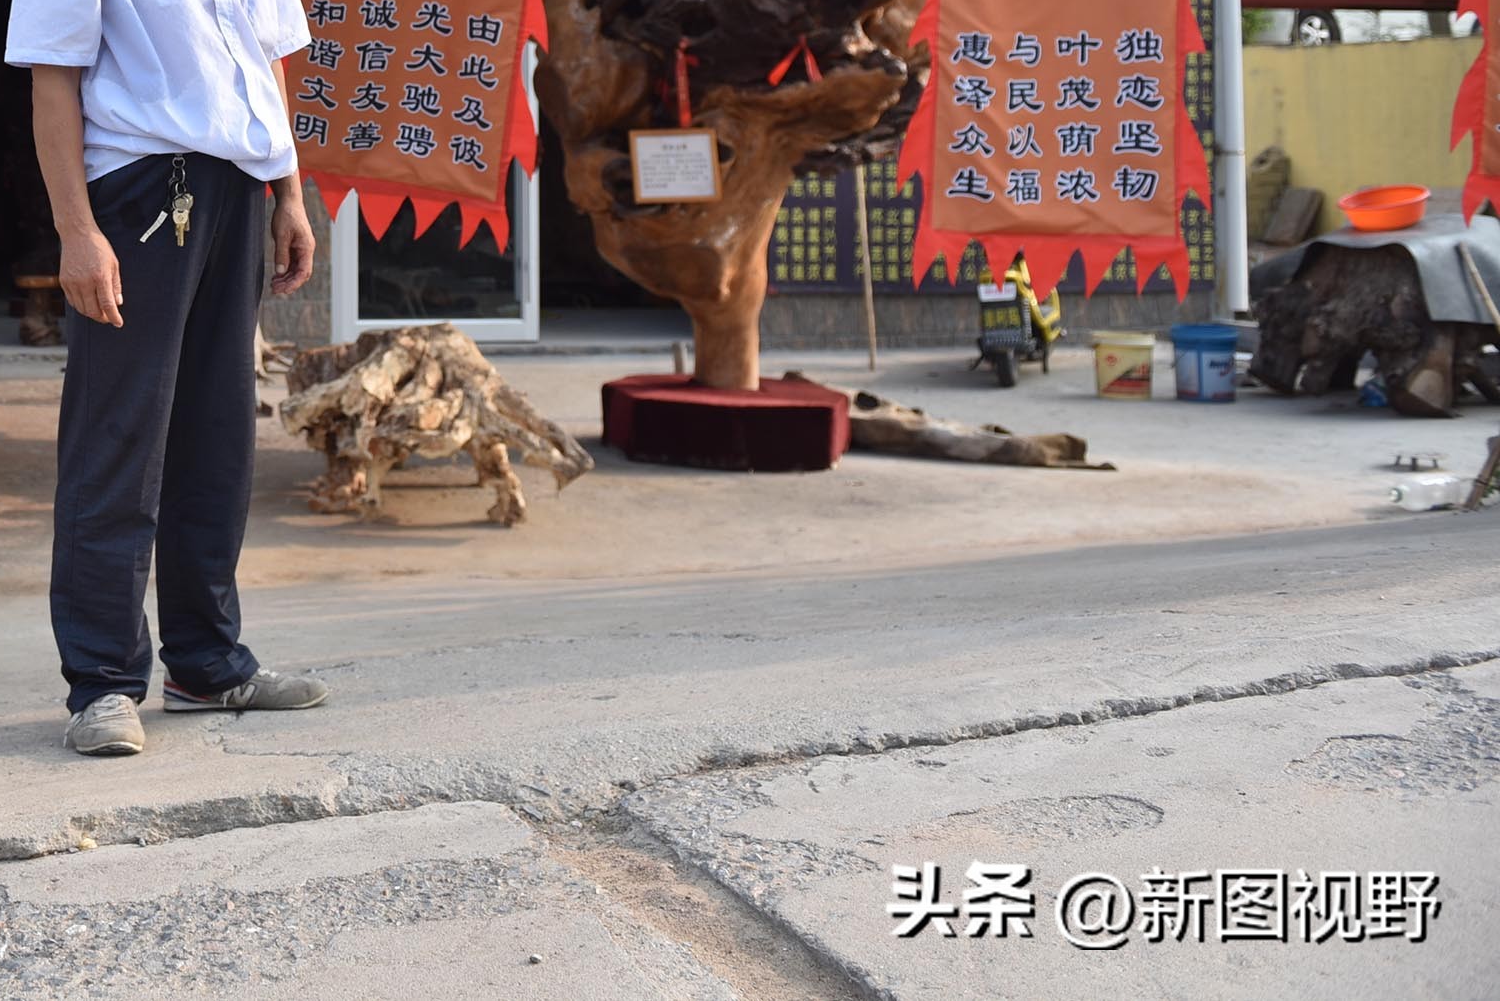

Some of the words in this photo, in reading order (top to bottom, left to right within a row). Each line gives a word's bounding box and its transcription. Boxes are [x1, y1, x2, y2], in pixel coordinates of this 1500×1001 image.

[343, 0, 399, 154] 诚信友善
[394, 2, 453, 160] 光大驰骋
[449, 12, 502, 173] 由此及彼
[947, 31, 995, 201] 惠泽众生
[1005, 32, 1044, 205] 与民以福
[1054, 30, 1103, 202] 叶茂荫浓
[1113, 29, 1165, 202] 独恋坚韧
